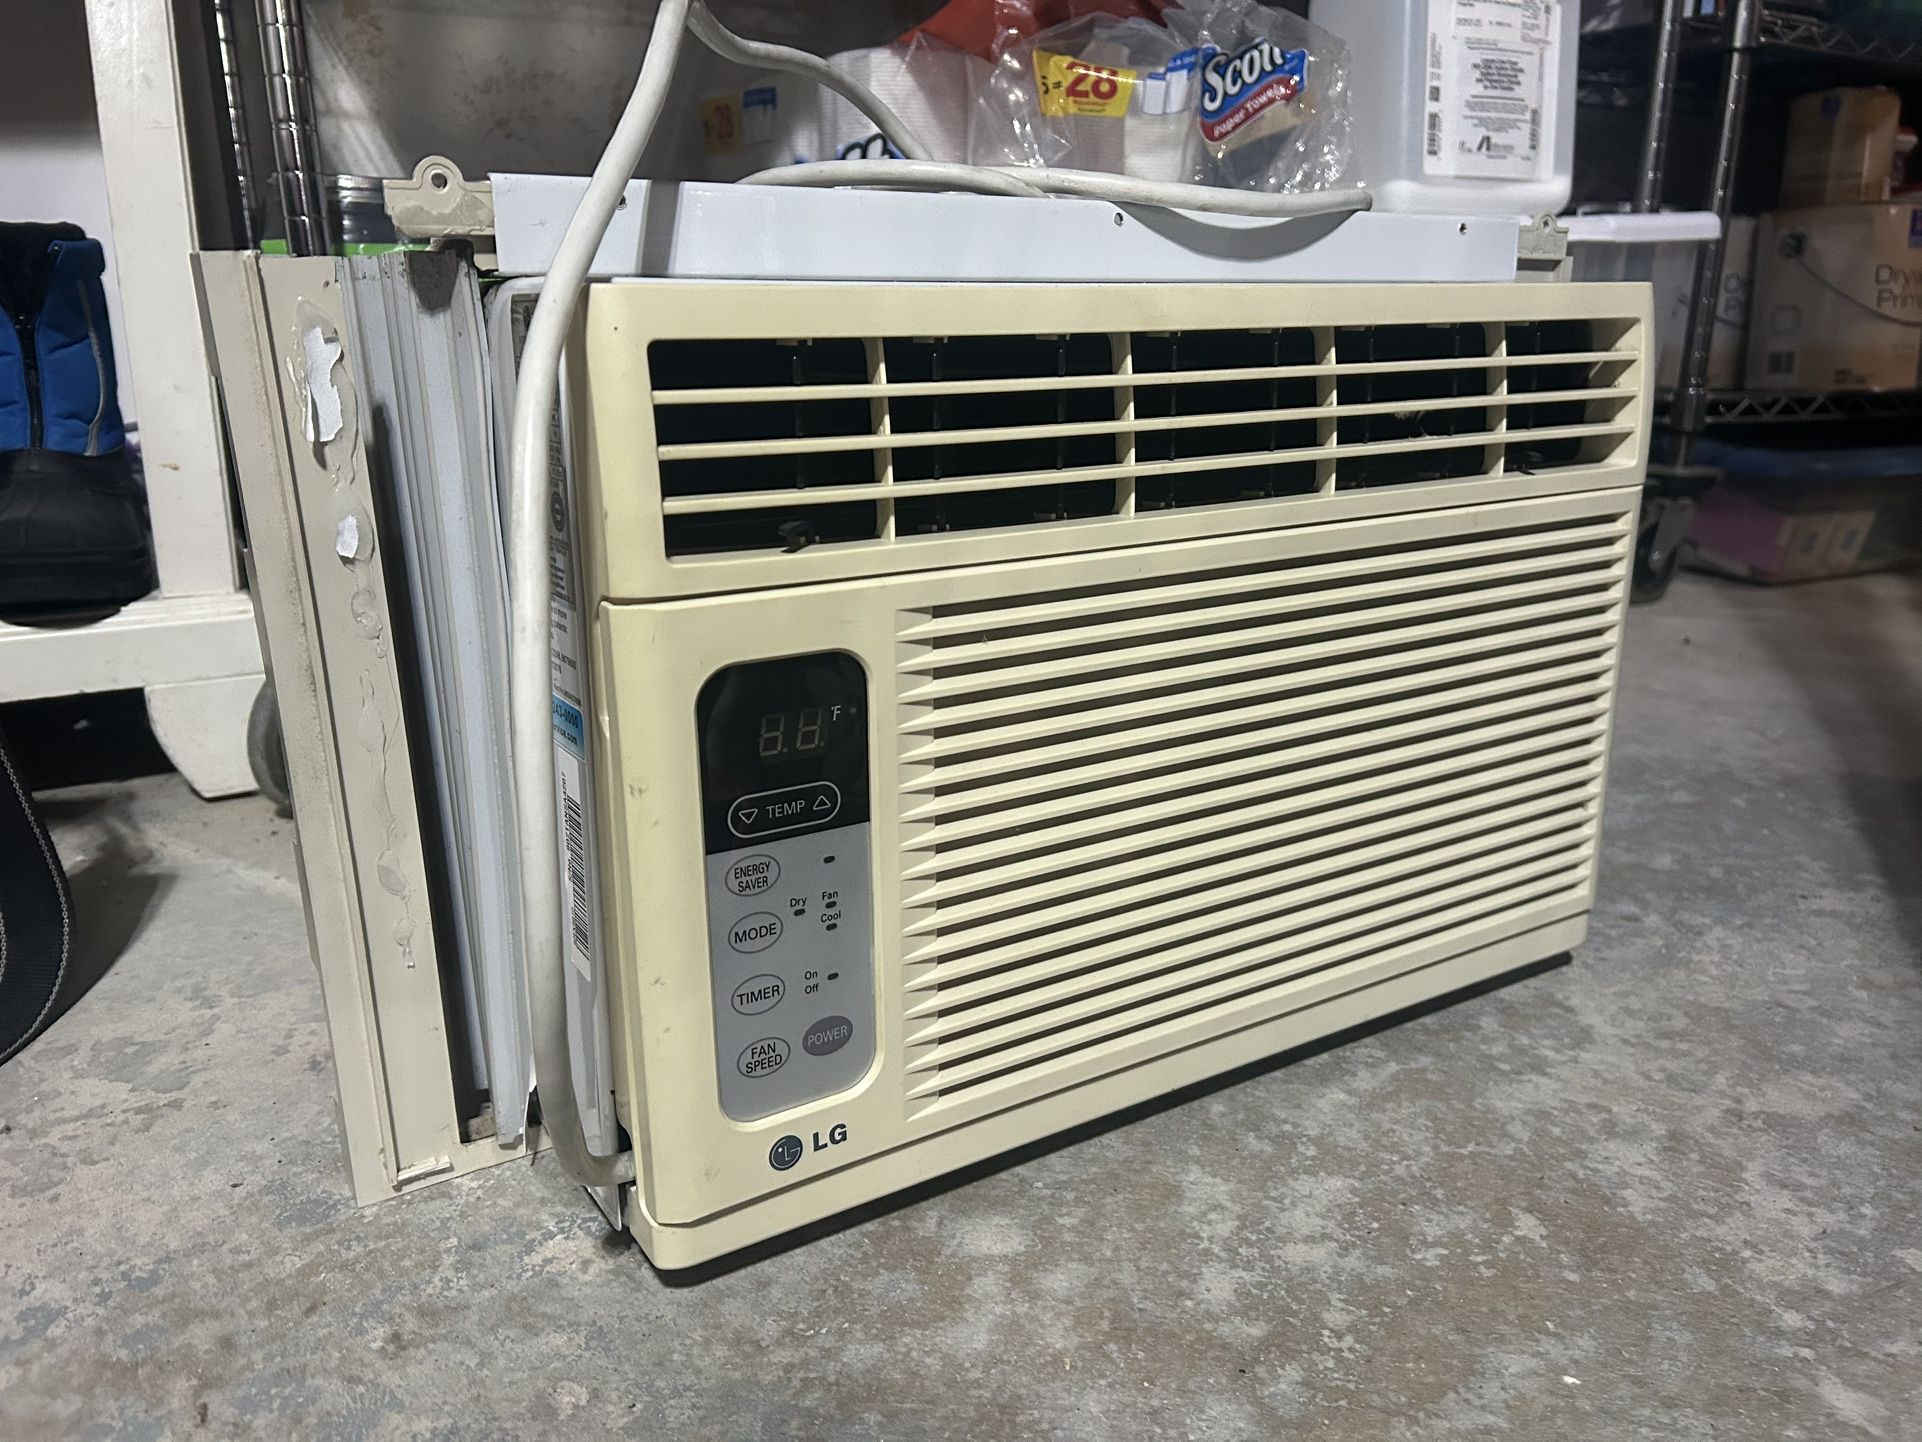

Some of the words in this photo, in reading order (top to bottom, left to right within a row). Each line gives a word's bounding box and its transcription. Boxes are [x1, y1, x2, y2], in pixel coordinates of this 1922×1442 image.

[1066, 61, 1118, 100] 28
[1213, 108, 1246, 138] Paper
[766, 800, 805, 819] TEMP
[734, 861, 771, 880] ENERGY
[738, 875, 769, 893] SAVER
[789, 897, 807, 908] Dry
[821, 890, 839, 901] Fan
[820, 910, 842, 923] Cool
[734, 922, 777, 945] MODE
[804, 970, 818, 981] On
[736, 984, 781, 1006] TIMER
[804, 982, 820, 995] Off
[807, 1025, 849, 1048] POWER
[750, 1041, 776, 1060] FAN
[745, 1053, 783, 1075] SPEED
[812, 1123, 848, 1152] LG
